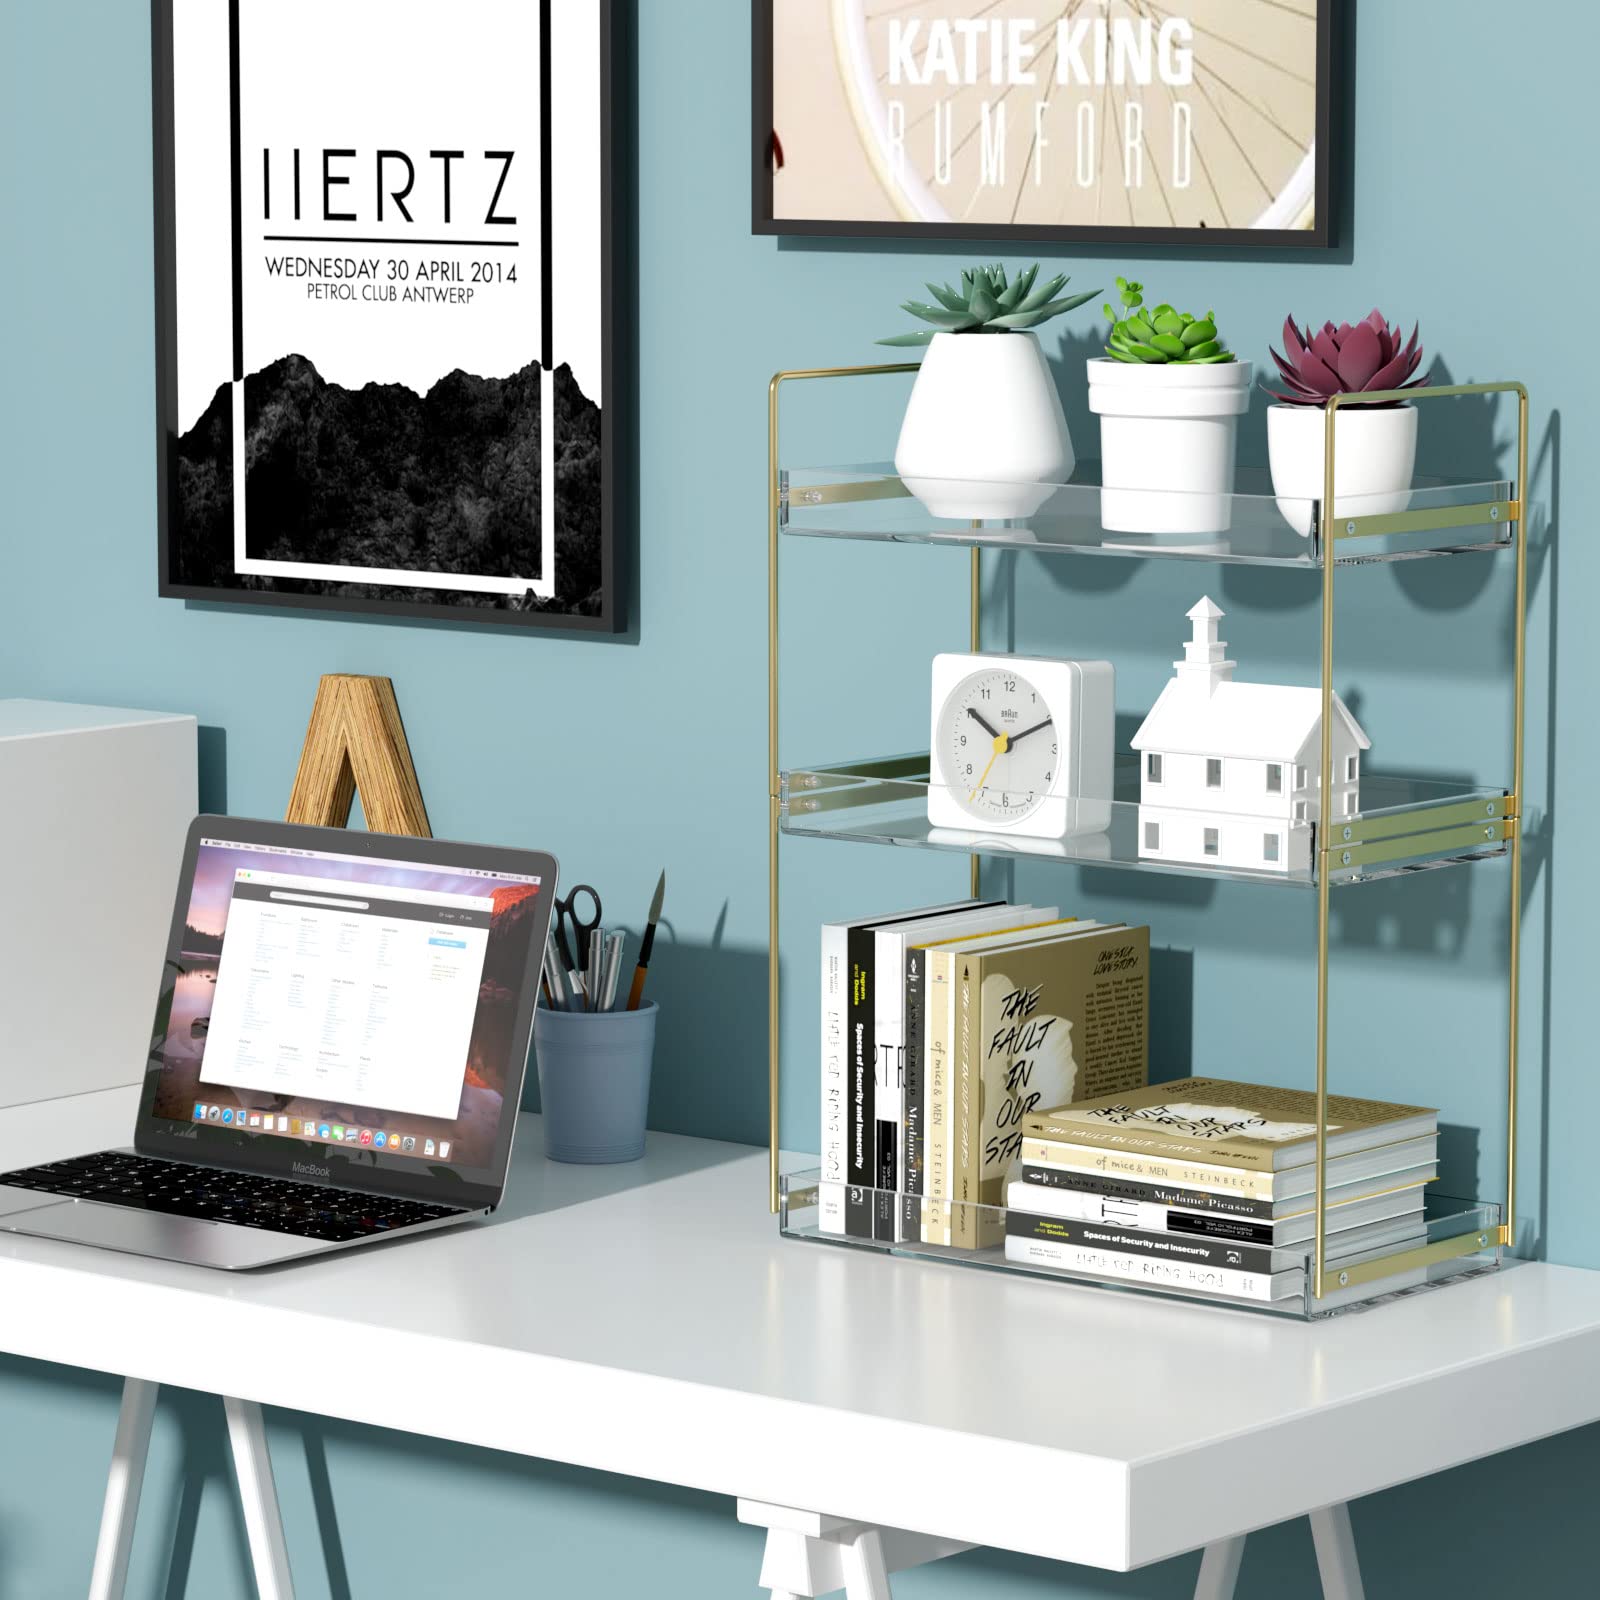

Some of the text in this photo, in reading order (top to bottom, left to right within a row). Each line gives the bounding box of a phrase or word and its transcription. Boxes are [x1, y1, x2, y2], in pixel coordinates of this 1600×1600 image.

[888, 17, 1193, 88] KATIE KING
[888, 101, 1191, 190] RUMFORD
[265, 256, 518, 284] WEDNESDAY 30 APRIL 2014
[307, 283, 475, 304] PETROL CLUB ANTWERP
[981, 689, 990, 700] 11
[1004, 681, 1016, 692] 12
[1032, 692, 1036, 704] 1
[960, 736, 967, 746] 9
[966, 764, 973, 775] 8
[1045, 772, 1051, 782] 4
[1001, 984, 1044, 1020] THE
[855, 1022, 864, 1054] Spaces
[930, 1041, 945, 1054] of
[988, 1018, 1056, 1059] FAULT
[934, 1059, 944, 1086] mice
[1006, 1060, 1034, 1090] IN
[855, 1066, 864, 1104] Security
[856, 1105, 864, 1122] and
[932, 1103, 942, 1125] MEN
[996, 1092, 1041, 1128] OUR
[1088, 1103, 1131, 1118] THE
[1108, 1106, 1172, 1124] FAULT
[854, 1123, 864, 1169] Insecurity
[908, 1106, 918, 1163] Madame
[985, 1131, 1023, 1165] STA
[292, 1161, 330, 1178] MacBook
[1096, 1156, 1168, 1177] of mice & MEN
[931, 1143, 942, 1224] STEINBECK
[1184, 1172, 1255, 1188] STEINBECK
[1154, 1190, 1254, 1214] Madame Picasso
[1083, 1230, 1111, 1242] Spaces
[1120, 1236, 1154, 1250] Security
[1154, 1241, 1169, 1250] and
[1170, 1244, 1210, 1258] Insecurity
